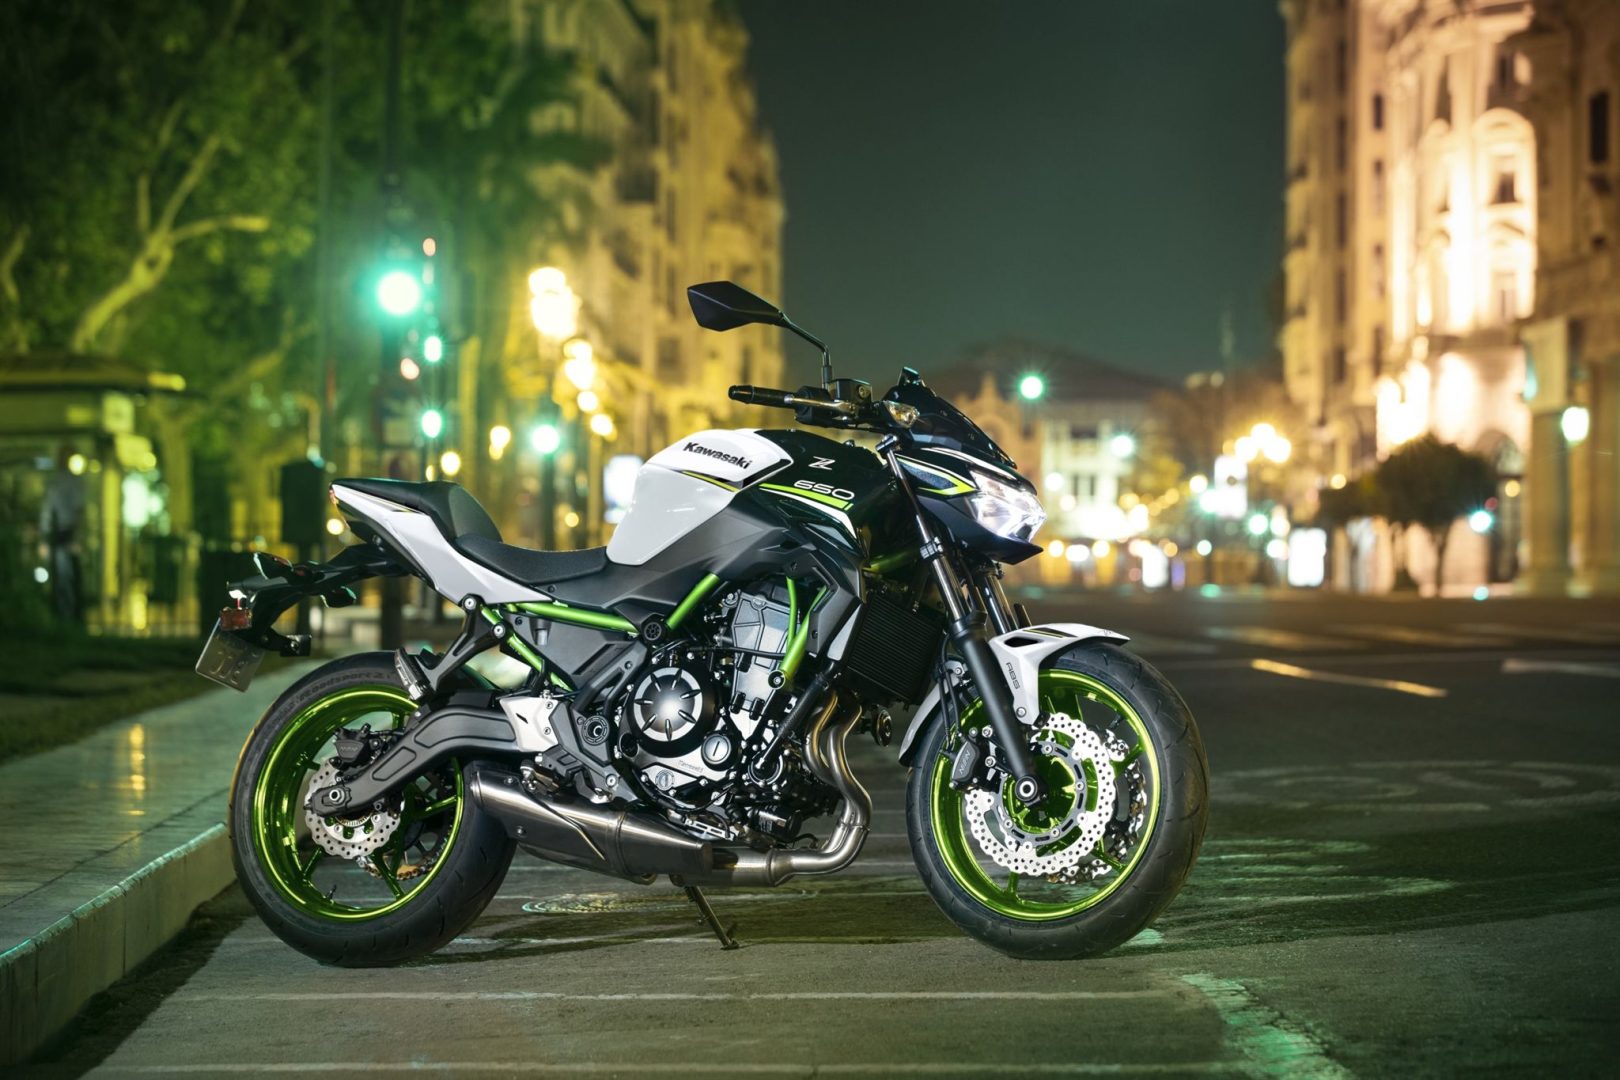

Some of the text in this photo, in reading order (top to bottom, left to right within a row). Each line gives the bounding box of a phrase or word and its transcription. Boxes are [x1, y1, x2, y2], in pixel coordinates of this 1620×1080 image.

[682, 442, 752, 470] Kawasaki
[808, 455, 836, 471] Z
[793, 479, 855, 500] 650
[1006, 662, 1020, 690] ABS
